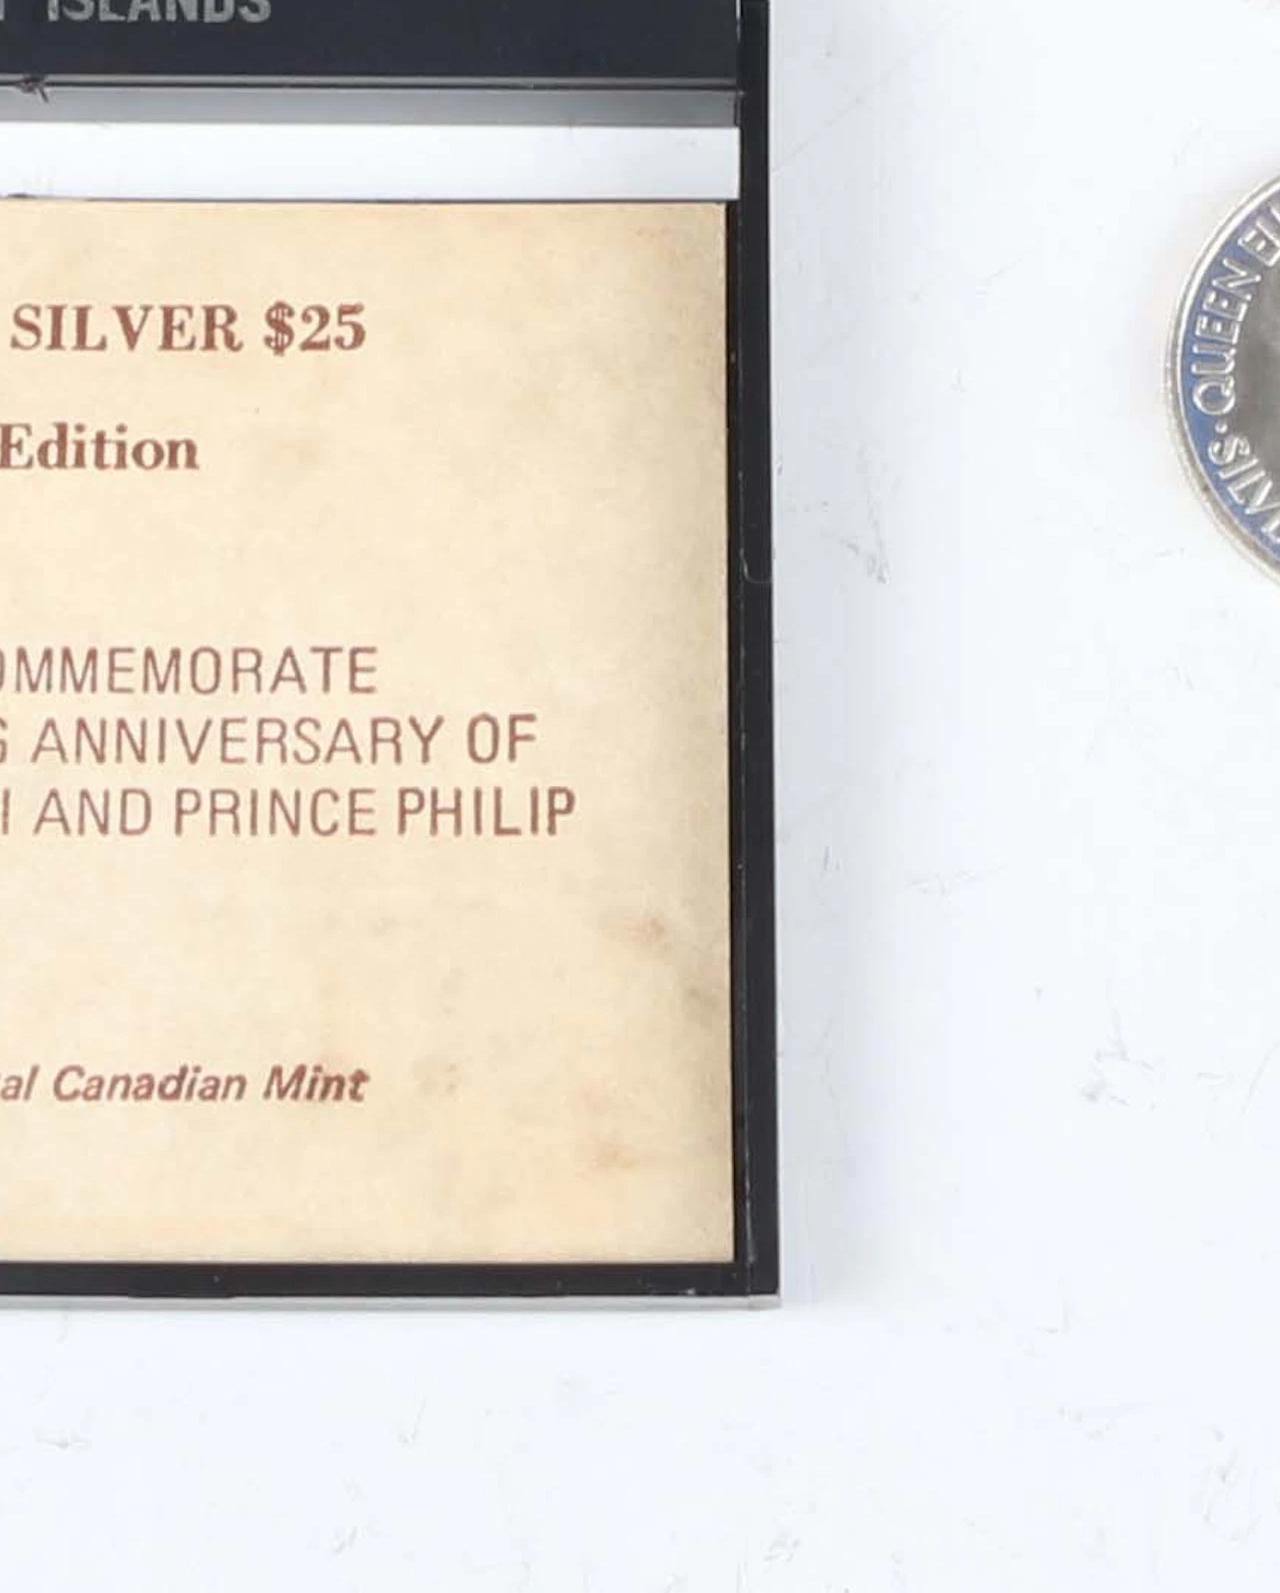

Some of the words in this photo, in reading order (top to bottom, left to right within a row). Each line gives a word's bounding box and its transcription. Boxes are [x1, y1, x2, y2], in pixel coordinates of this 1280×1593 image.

[9, 303, 245, 354] SILVER
[262, 300, 367, 358] $25
[1191, 255, 1263, 419] QUEEN
[30, 714, 445, 766] ANNIVERSARY
[466, 711, 538, 765] OF
[32, 787, 153, 837] AND
[173, 787, 377, 838] PRINCE
[397, 785, 577, 837] PHILIP
[52, 1063, 249, 1103] Canadian
[262, 1063, 371, 1104] Mint
